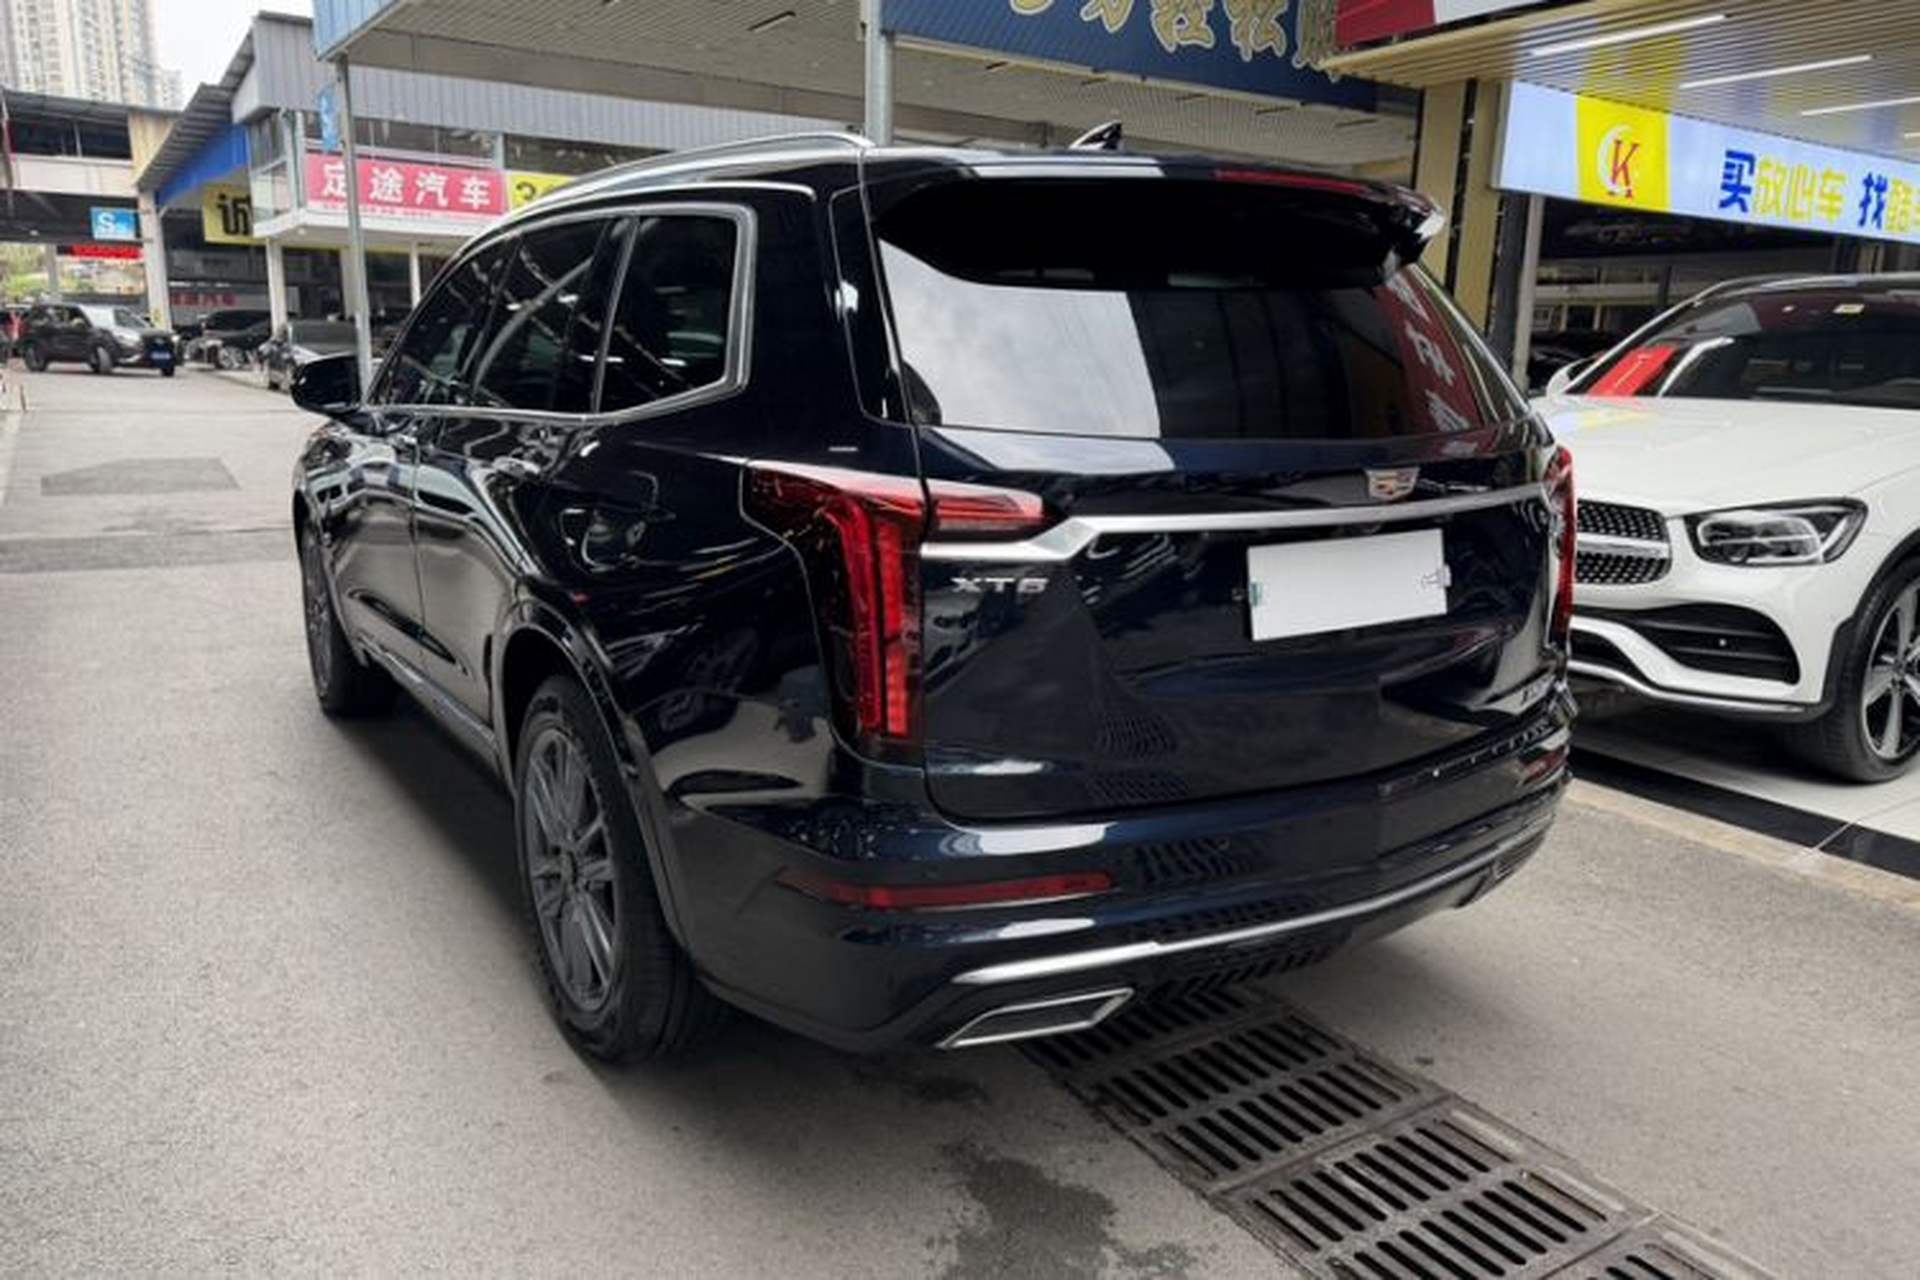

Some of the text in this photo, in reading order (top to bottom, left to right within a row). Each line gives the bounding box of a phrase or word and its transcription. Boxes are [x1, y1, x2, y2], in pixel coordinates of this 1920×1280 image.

[322, 163, 492, 209] 定途汽车
[1718, 149, 1847, 223] 买放心车
[950, 576, 1050, 594] XT6
